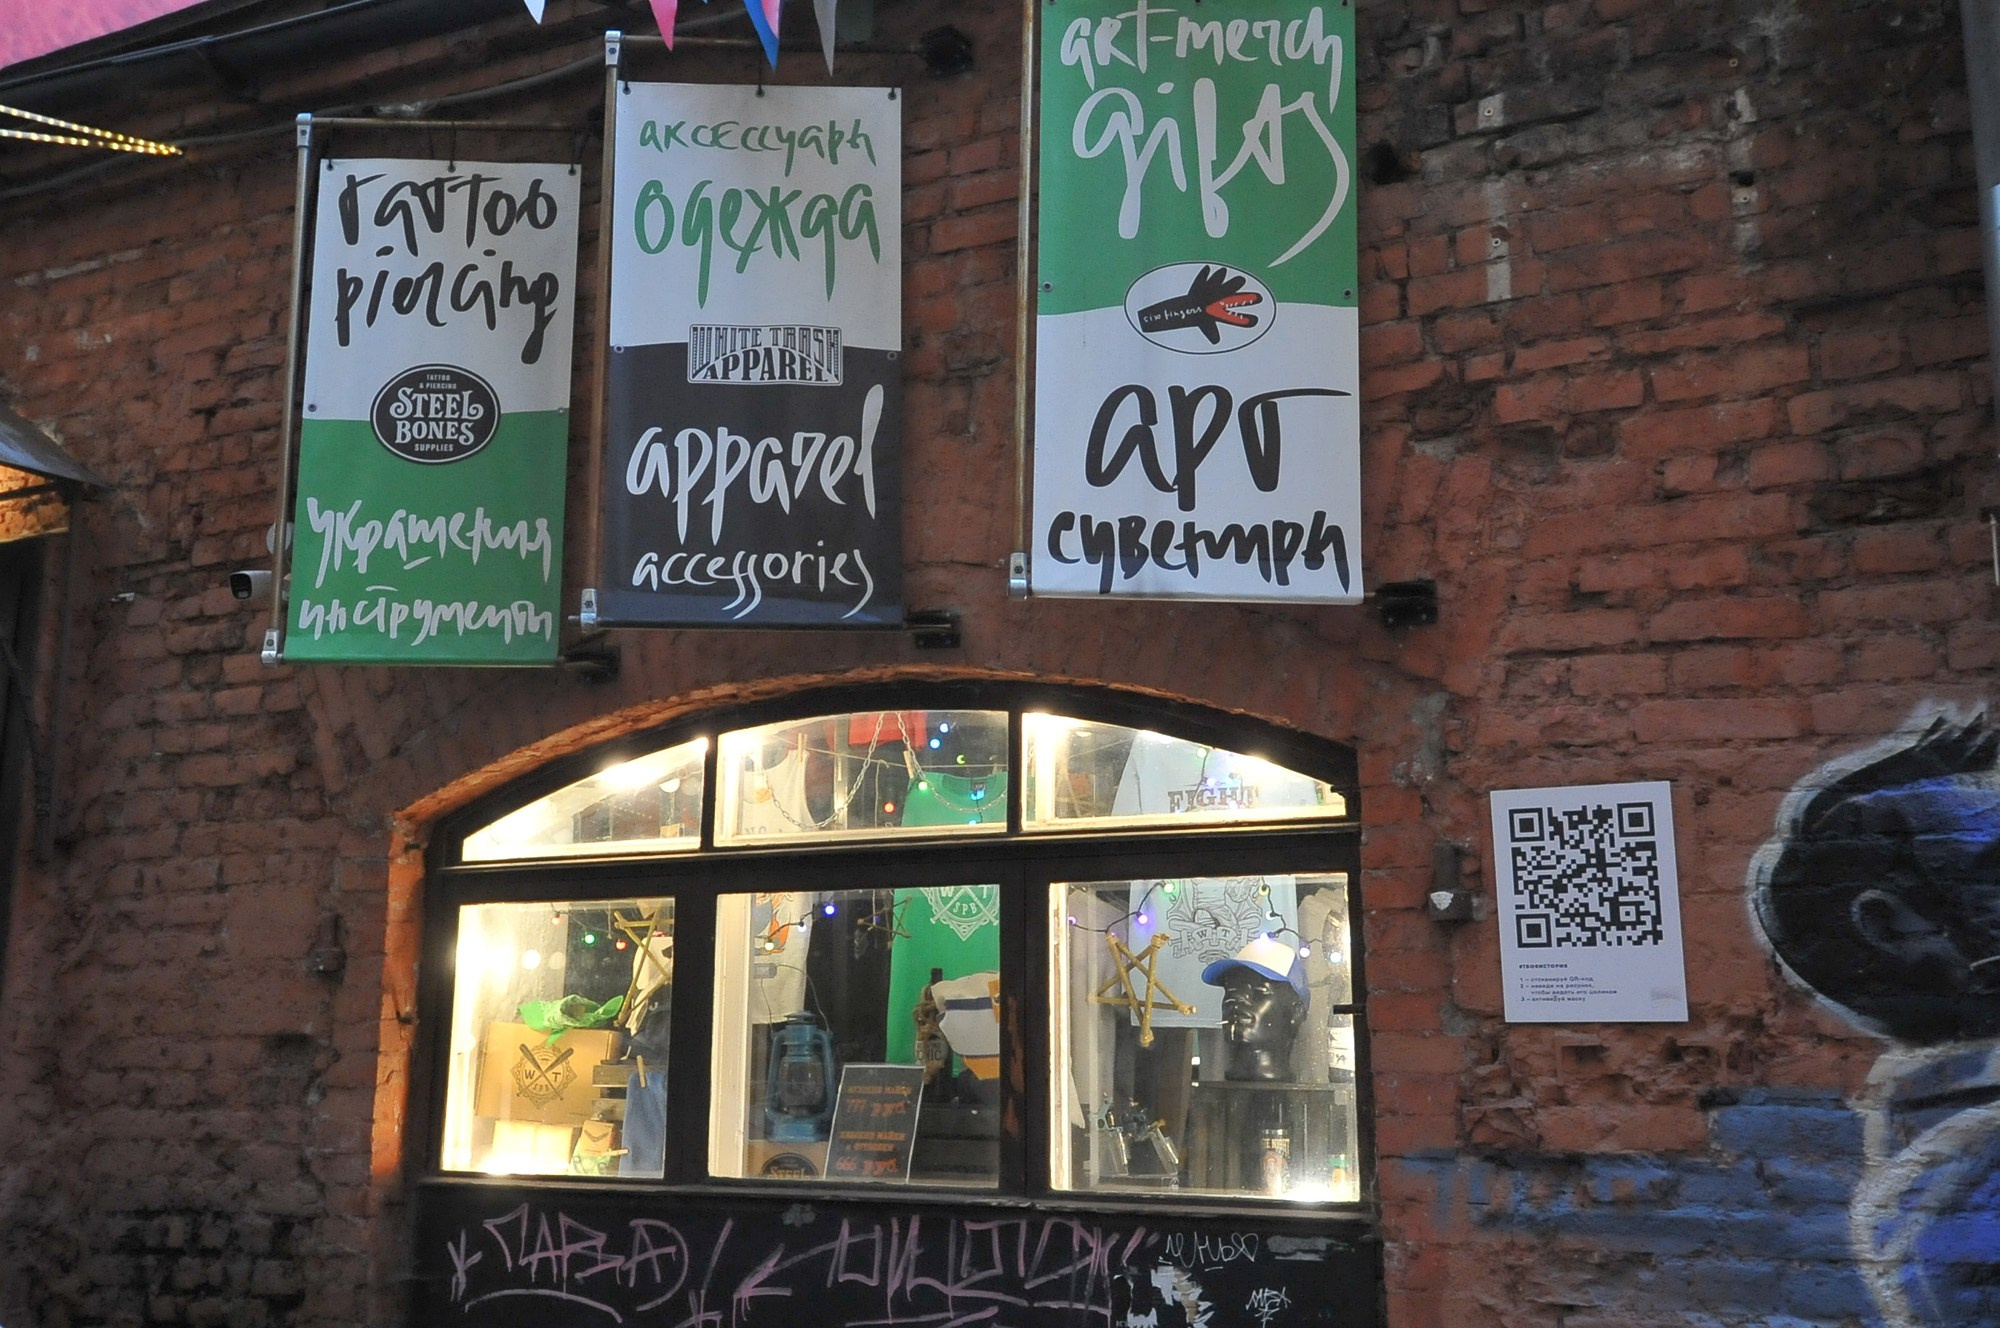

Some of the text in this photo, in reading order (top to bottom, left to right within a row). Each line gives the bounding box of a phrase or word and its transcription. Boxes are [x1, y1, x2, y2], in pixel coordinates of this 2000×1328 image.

[638, 118, 876, 176] аксессуары
[1072, 77, 1350, 267] gifts
[338, 173, 558, 257] tattoo
[334, 245, 560, 365] piercing
[692, 326, 840, 381] WHITE TRASH
[702, 347, 829, 382] APPAREL
[389, 387, 484, 420] STEEL
[426, 382, 457, 390] PIERCING
[395, 420, 475, 446] BONES
[414, 443, 454, 452] SUPPLIES
[1085, 383, 1352, 511] арт
[625, 383, 885, 546] apparel
[306, 496, 552, 589] украшения
[1047, 509, 1350, 594] сувениры
[631, 539, 874, 619] accessories
[298, 585, 553, 646] инструменты
[953, 902, 978, 915] SPB
[524, 1068, 562, 1082] W T
